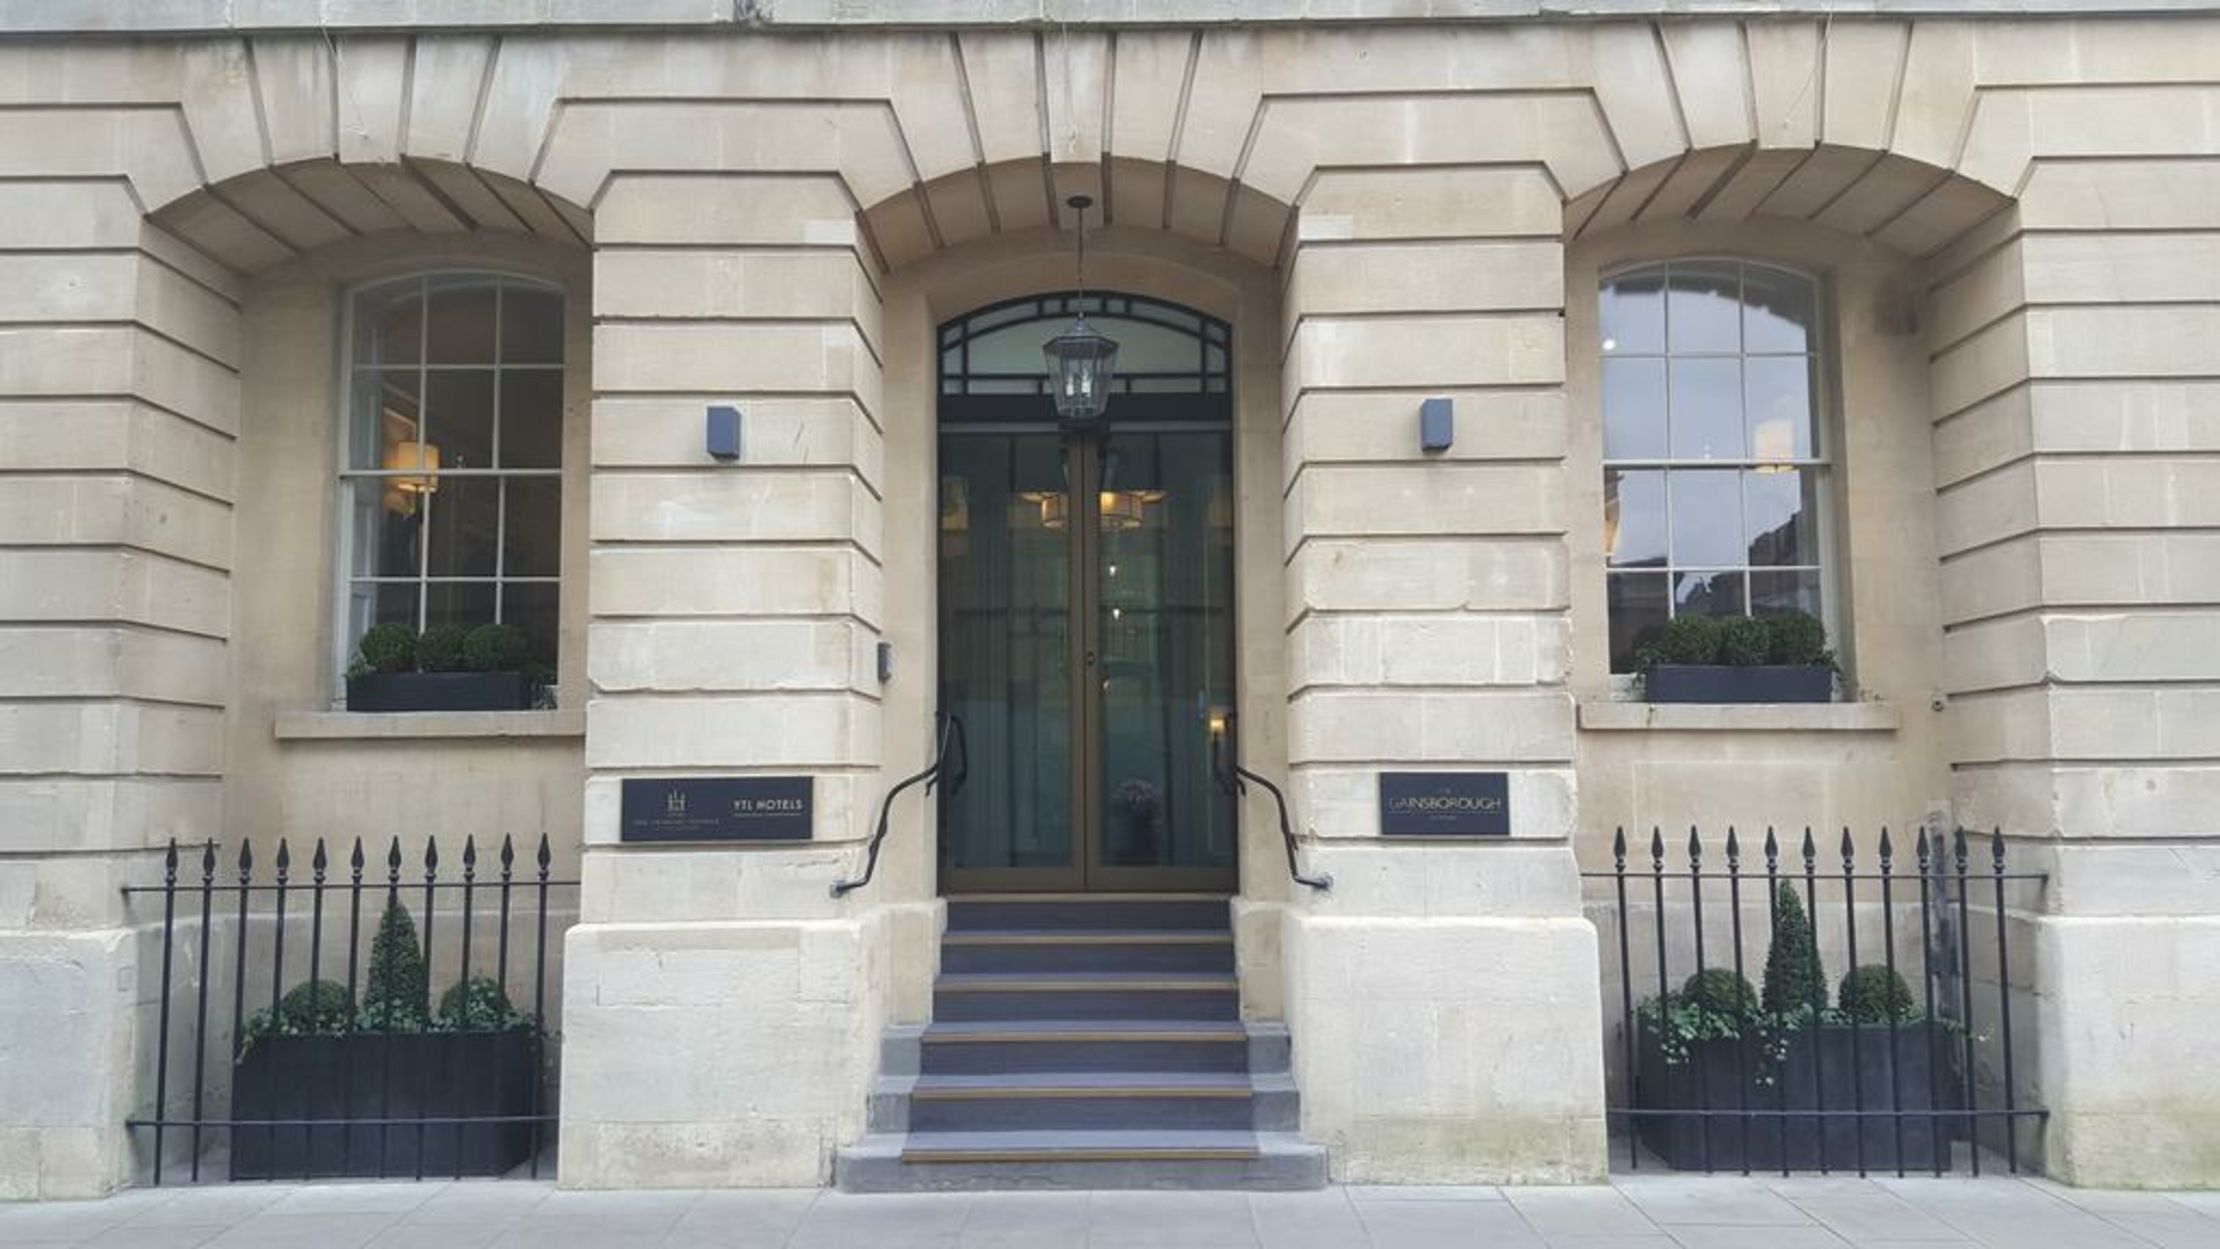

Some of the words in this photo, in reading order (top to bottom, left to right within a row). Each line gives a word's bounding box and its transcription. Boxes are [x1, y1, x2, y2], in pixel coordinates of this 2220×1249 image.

[734, 800, 753, 811] YTL
[756, 799, 803, 810] HOTELS
[1388, 797, 1501, 809] GAINSBOROUGH
